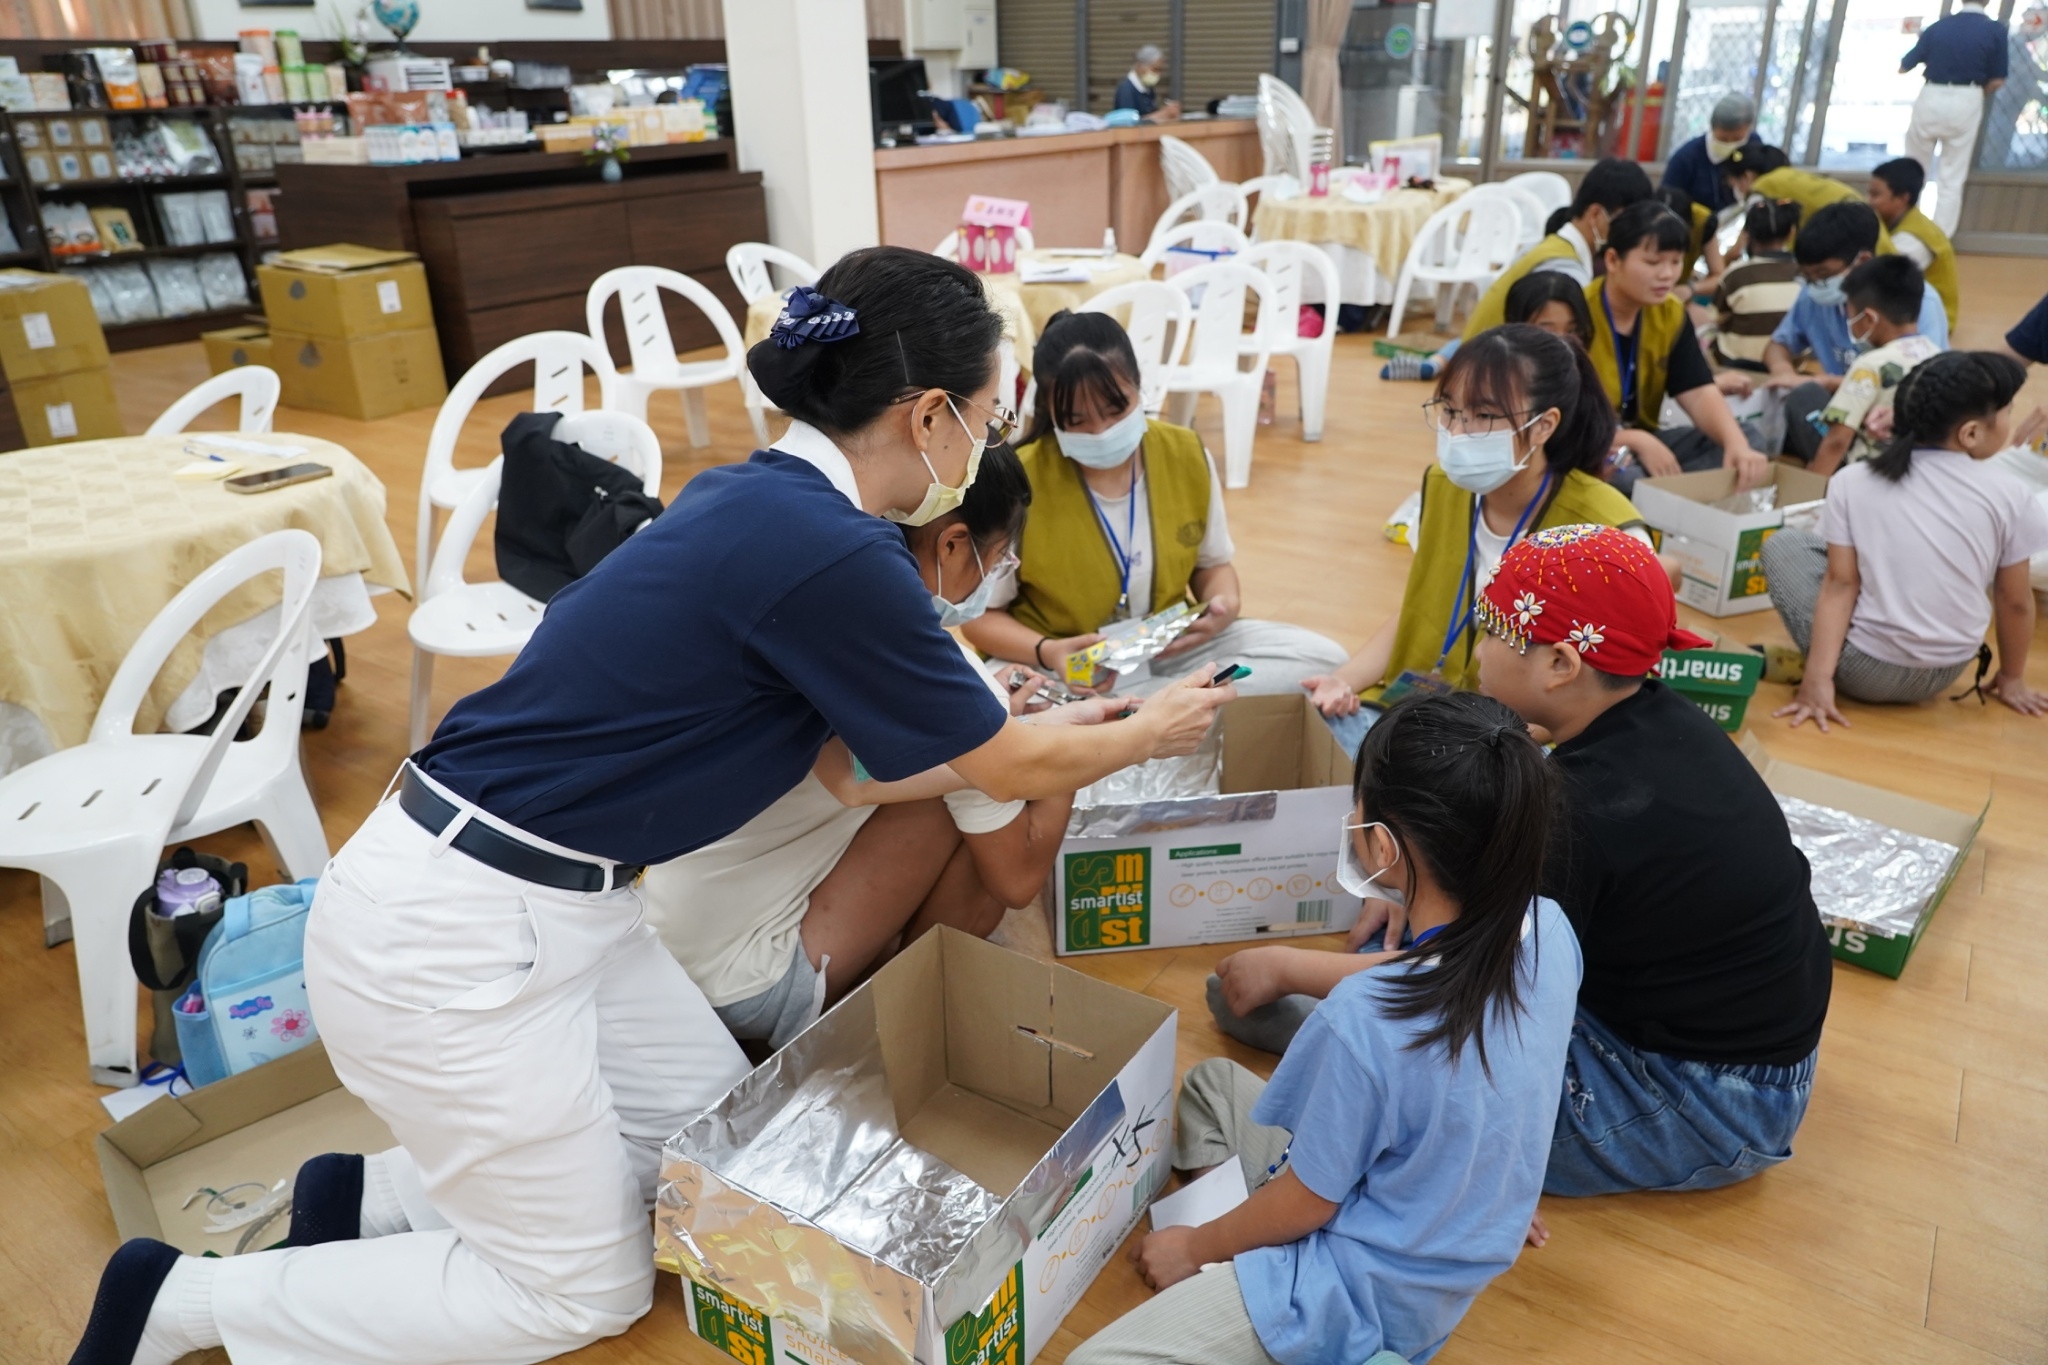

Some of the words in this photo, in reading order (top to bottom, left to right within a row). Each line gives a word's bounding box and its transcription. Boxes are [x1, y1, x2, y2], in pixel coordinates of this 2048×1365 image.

[1652, 657, 1744, 682] smarti
[1070, 890, 1143, 911] smartist
[696, 1287, 765, 1336] smartist
